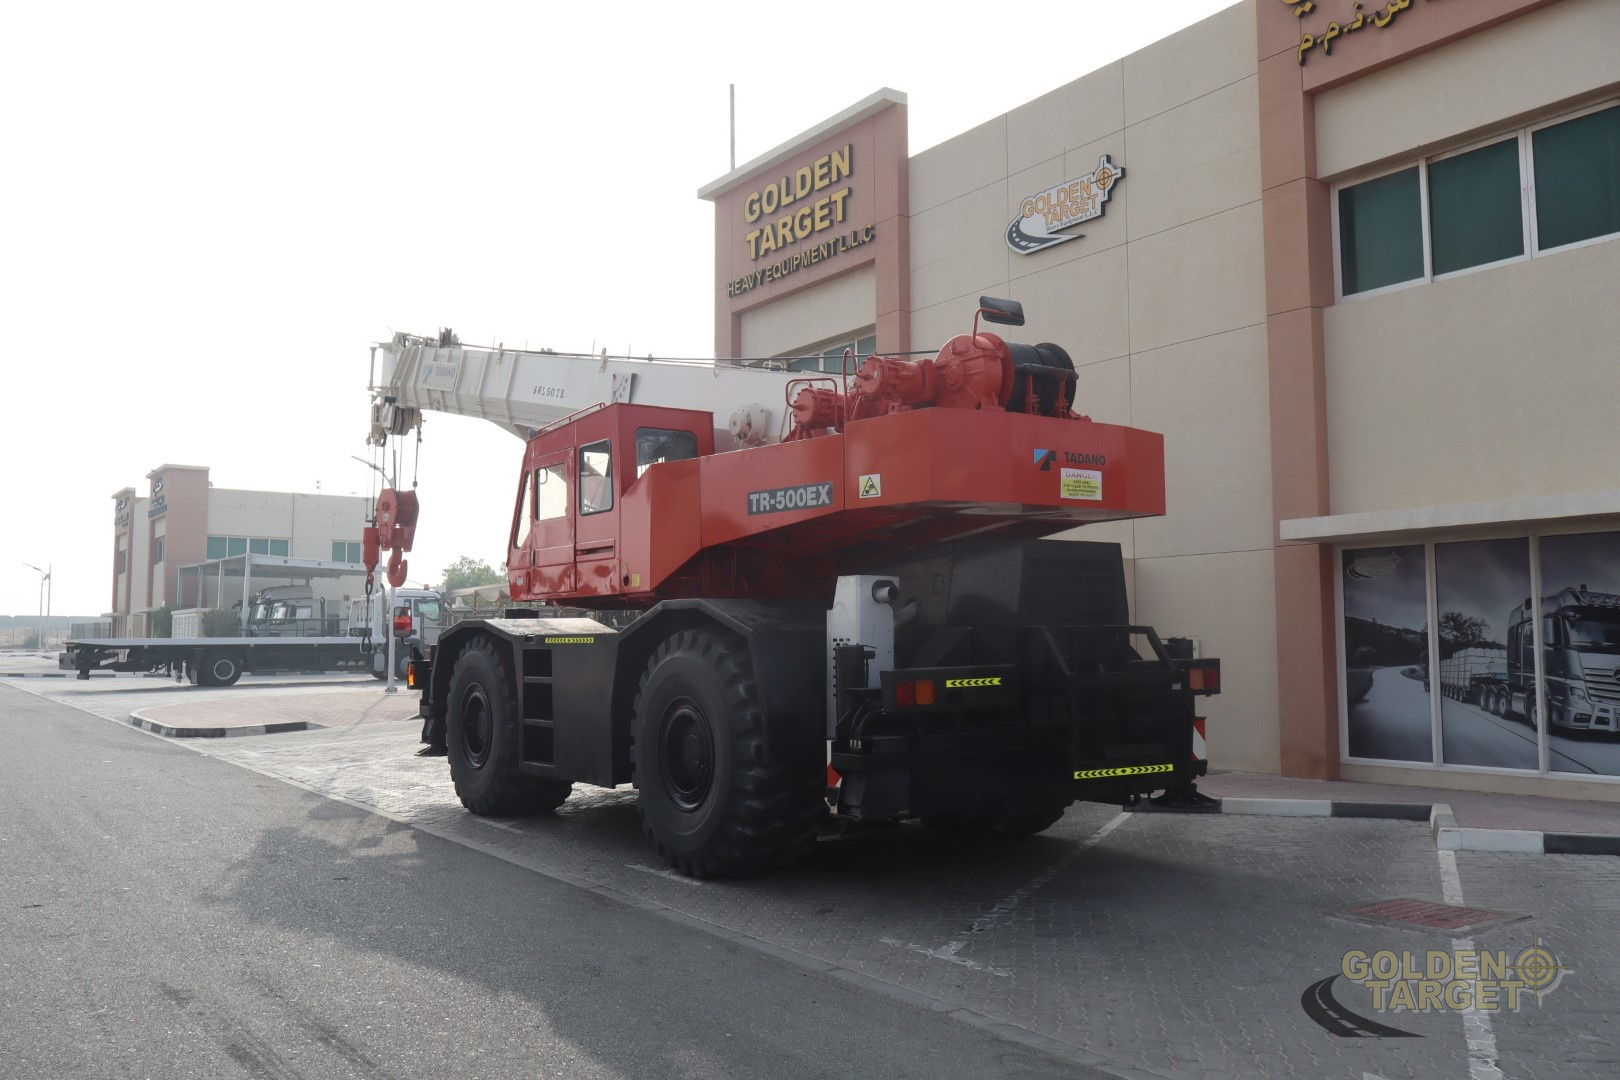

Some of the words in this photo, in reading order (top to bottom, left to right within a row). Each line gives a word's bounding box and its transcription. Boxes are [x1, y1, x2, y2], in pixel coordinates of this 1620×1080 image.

[744, 144, 852, 223] GOLDEN
[1023, 177, 1092, 218] GOLDEN
[745, 187, 851, 261] TARGET
[1043, 193, 1098, 226] TARGET
[727, 269, 765, 297] HEAVY
[766, 239, 839, 283] EQUIPMENT
[839, 224, 875, 252] L.L.C
[1063, 451, 1106, 466] TADANO
[1065, 471, 1099, 480] DANGER
[749, 484, 831, 513] TR-500EX
